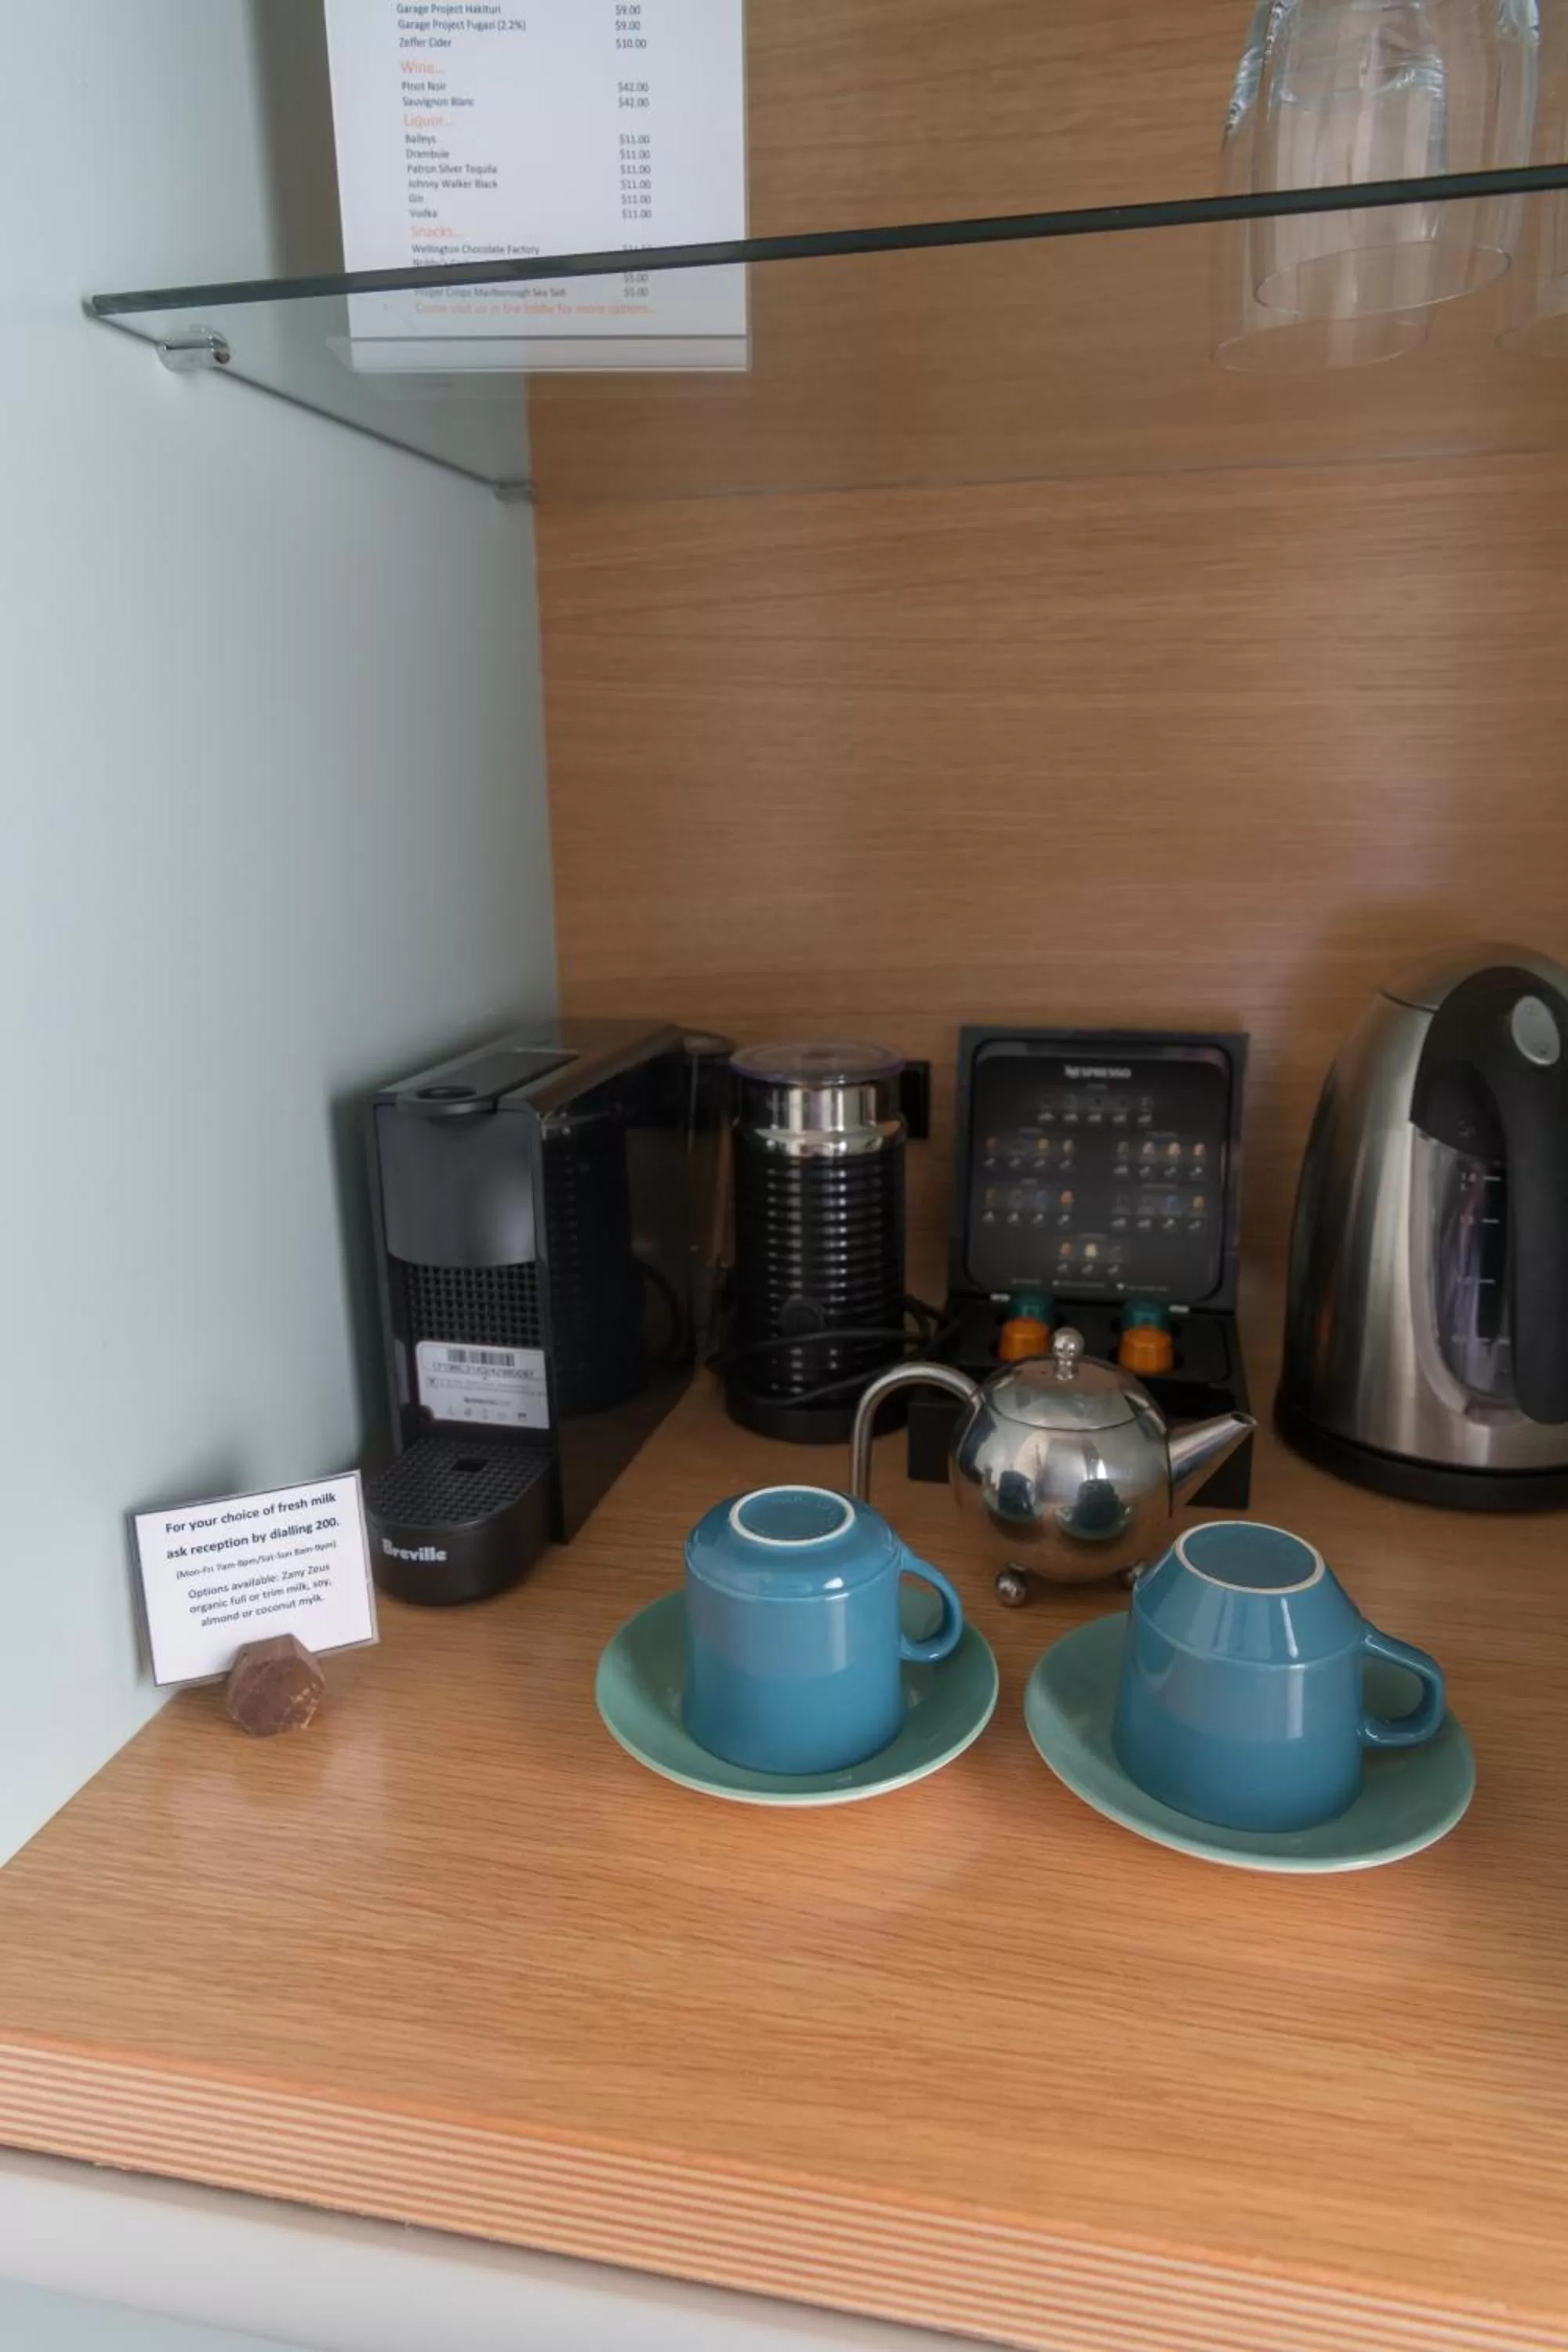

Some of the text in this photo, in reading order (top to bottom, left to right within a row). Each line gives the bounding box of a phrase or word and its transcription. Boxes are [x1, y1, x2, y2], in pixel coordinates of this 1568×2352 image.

[396, 3, 429, 15] Garage
[430, 3, 463, 16] Project
[397, 19, 430, 31] Garage
[432, 19, 465, 32] Project
[428, 37, 452, 48] Cider
[615, 38, 647, 49] $10.00
[401, 81, 447, 91] Pinot Noir
[617, 81, 649, 93] $42.00
[402, 96, 474, 108] Sauvignon Blanc
[618, 96, 650, 108] $42.00
[619, 133, 650, 145] $11.00
[619, 148, 651, 160] $11.00
[439, 164, 463, 174] Silver
[620, 164, 652, 176] $11.00
[441, 179, 472, 189] Walker
[474, 179, 498, 189] Black
[620, 179, 652, 190] $11.00
[408, 193, 424, 203] Gin
[621, 193, 652, 205] $11.00
[409, 209, 438, 218] Vodka
[622, 208, 652, 220] $11.00
[412, 244, 540, 256] Wellington Chocolate Factory
[165, 1492, 336, 1534] For your choice of fresh milk
[165, 1516, 339, 1559] ask reception by dialling 200.
[382, 1537, 448, 1563] Breville
[176, 1565, 215, 1581] (Mon-Fri
[187, 1563, 331, 1600] Options available: Zany Zeus
[189, 1596, 228, 1614] organic
[230, 1592, 246, 1606] full
[249, 1593, 260, 1602] or
[262, 1586, 285, 1600] trim
[285, 1580, 310, 1595] milk,
[201, 1611, 240, 1628] almond
[242, 1609, 253, 1619] or
[255, 1600, 296, 1617] coconut
